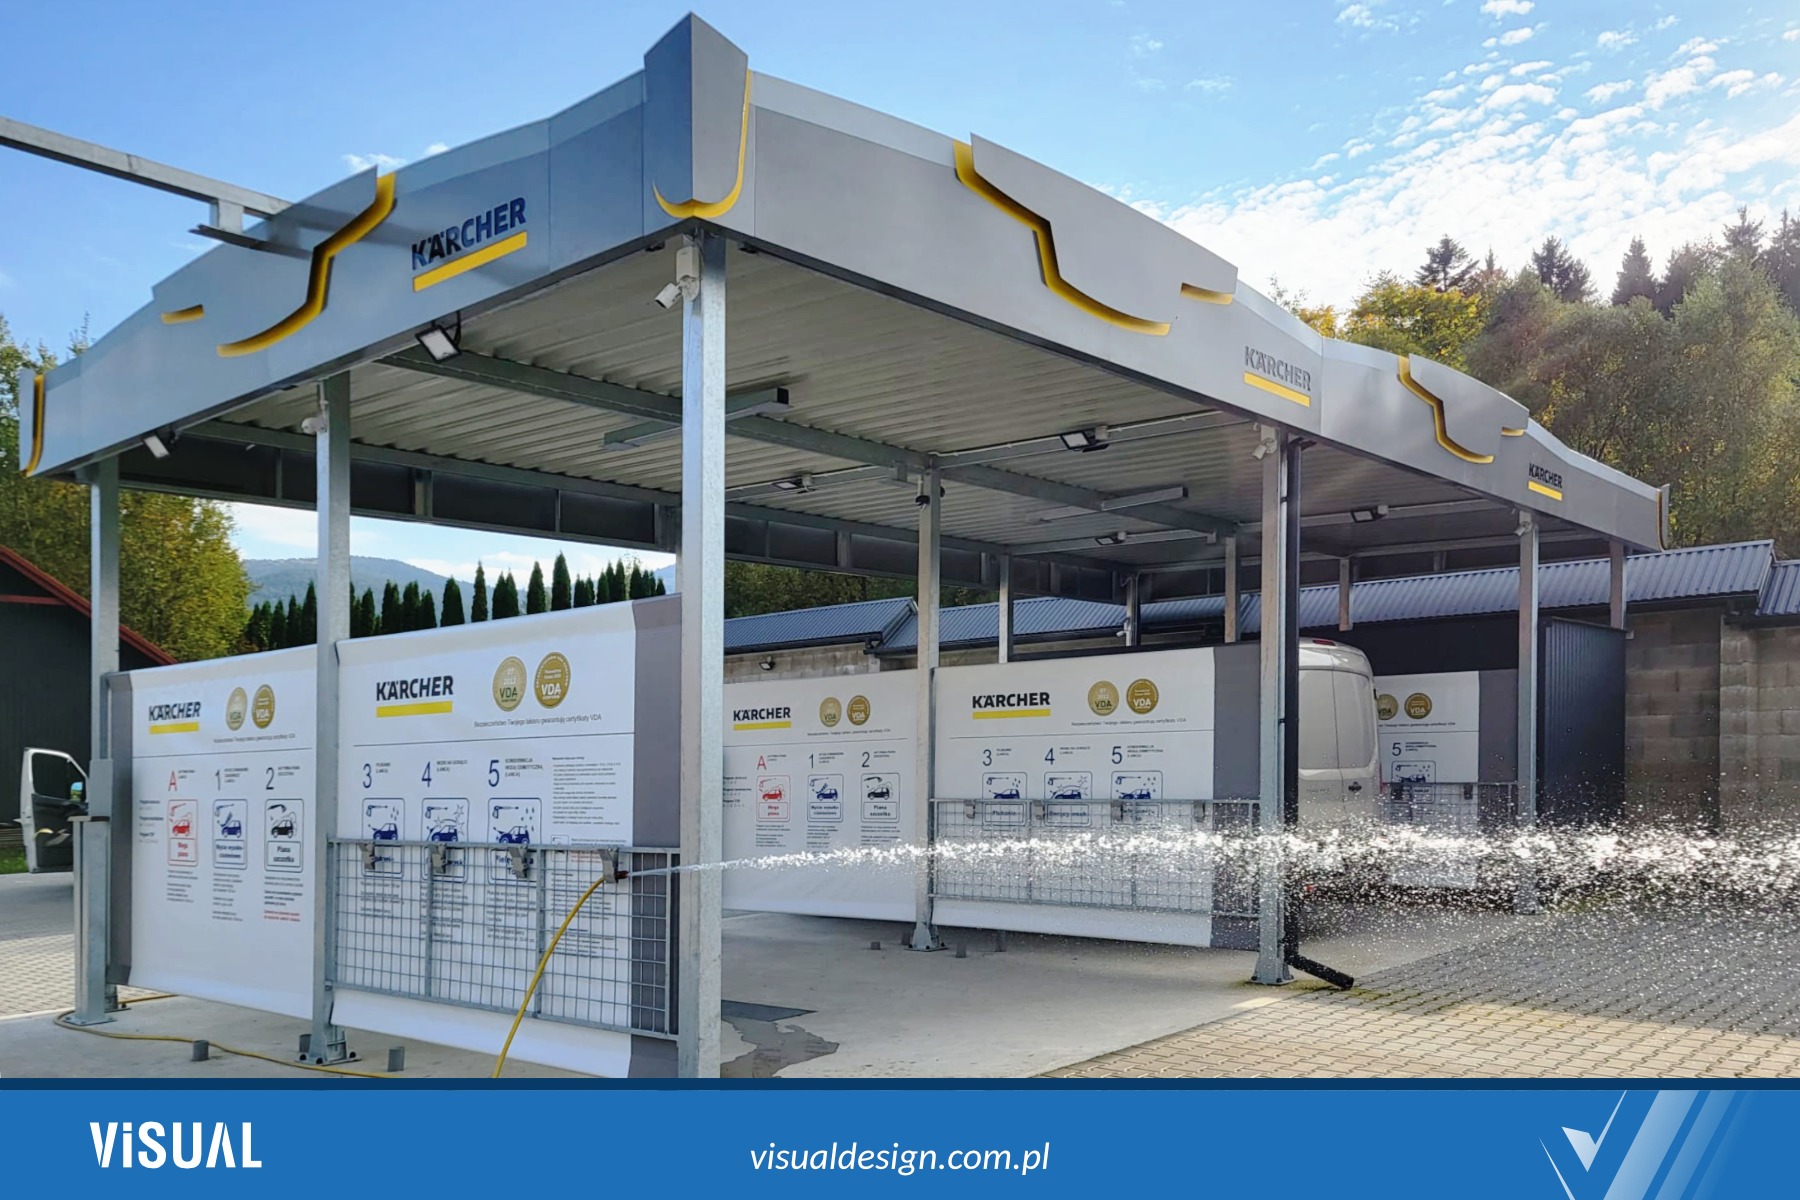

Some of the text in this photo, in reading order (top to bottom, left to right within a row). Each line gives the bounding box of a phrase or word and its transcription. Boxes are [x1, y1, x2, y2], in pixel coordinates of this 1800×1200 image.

[411, 197, 527, 270] KÄRCHER
[1244, 345, 1312, 392] KÄRCHER
[1528, 462, 1563, 489] KÄRCHER
[376, 675, 454, 701] KÄRCHER
[500, 687, 518, 698] VDA
[541, 683, 562, 695] VDA
[972, 691, 1051, 709] KÄRCHER
[1094, 700, 1112, 708] VDA
[1133, 698, 1152, 707] VDA
[149, 701, 201, 721] KÄRCHER
[733, 706, 791, 721] KÄRCHER
[982, 749, 992, 767] 3
[1044, 748, 1055, 765] 4
[1111, 746, 1122, 764] 5
[1392, 742, 1402, 756] 5
[757, 755, 767, 770] A
[808, 753, 814, 769] 1
[861, 751, 870, 768] 2
[168, 770, 178, 791] A
[215, 769, 221, 791] 1
[265, 767, 275, 790] 2
[362, 763, 372, 788] 3
[421, 761, 432, 788] 4
[488, 759, 500, 787] 5
